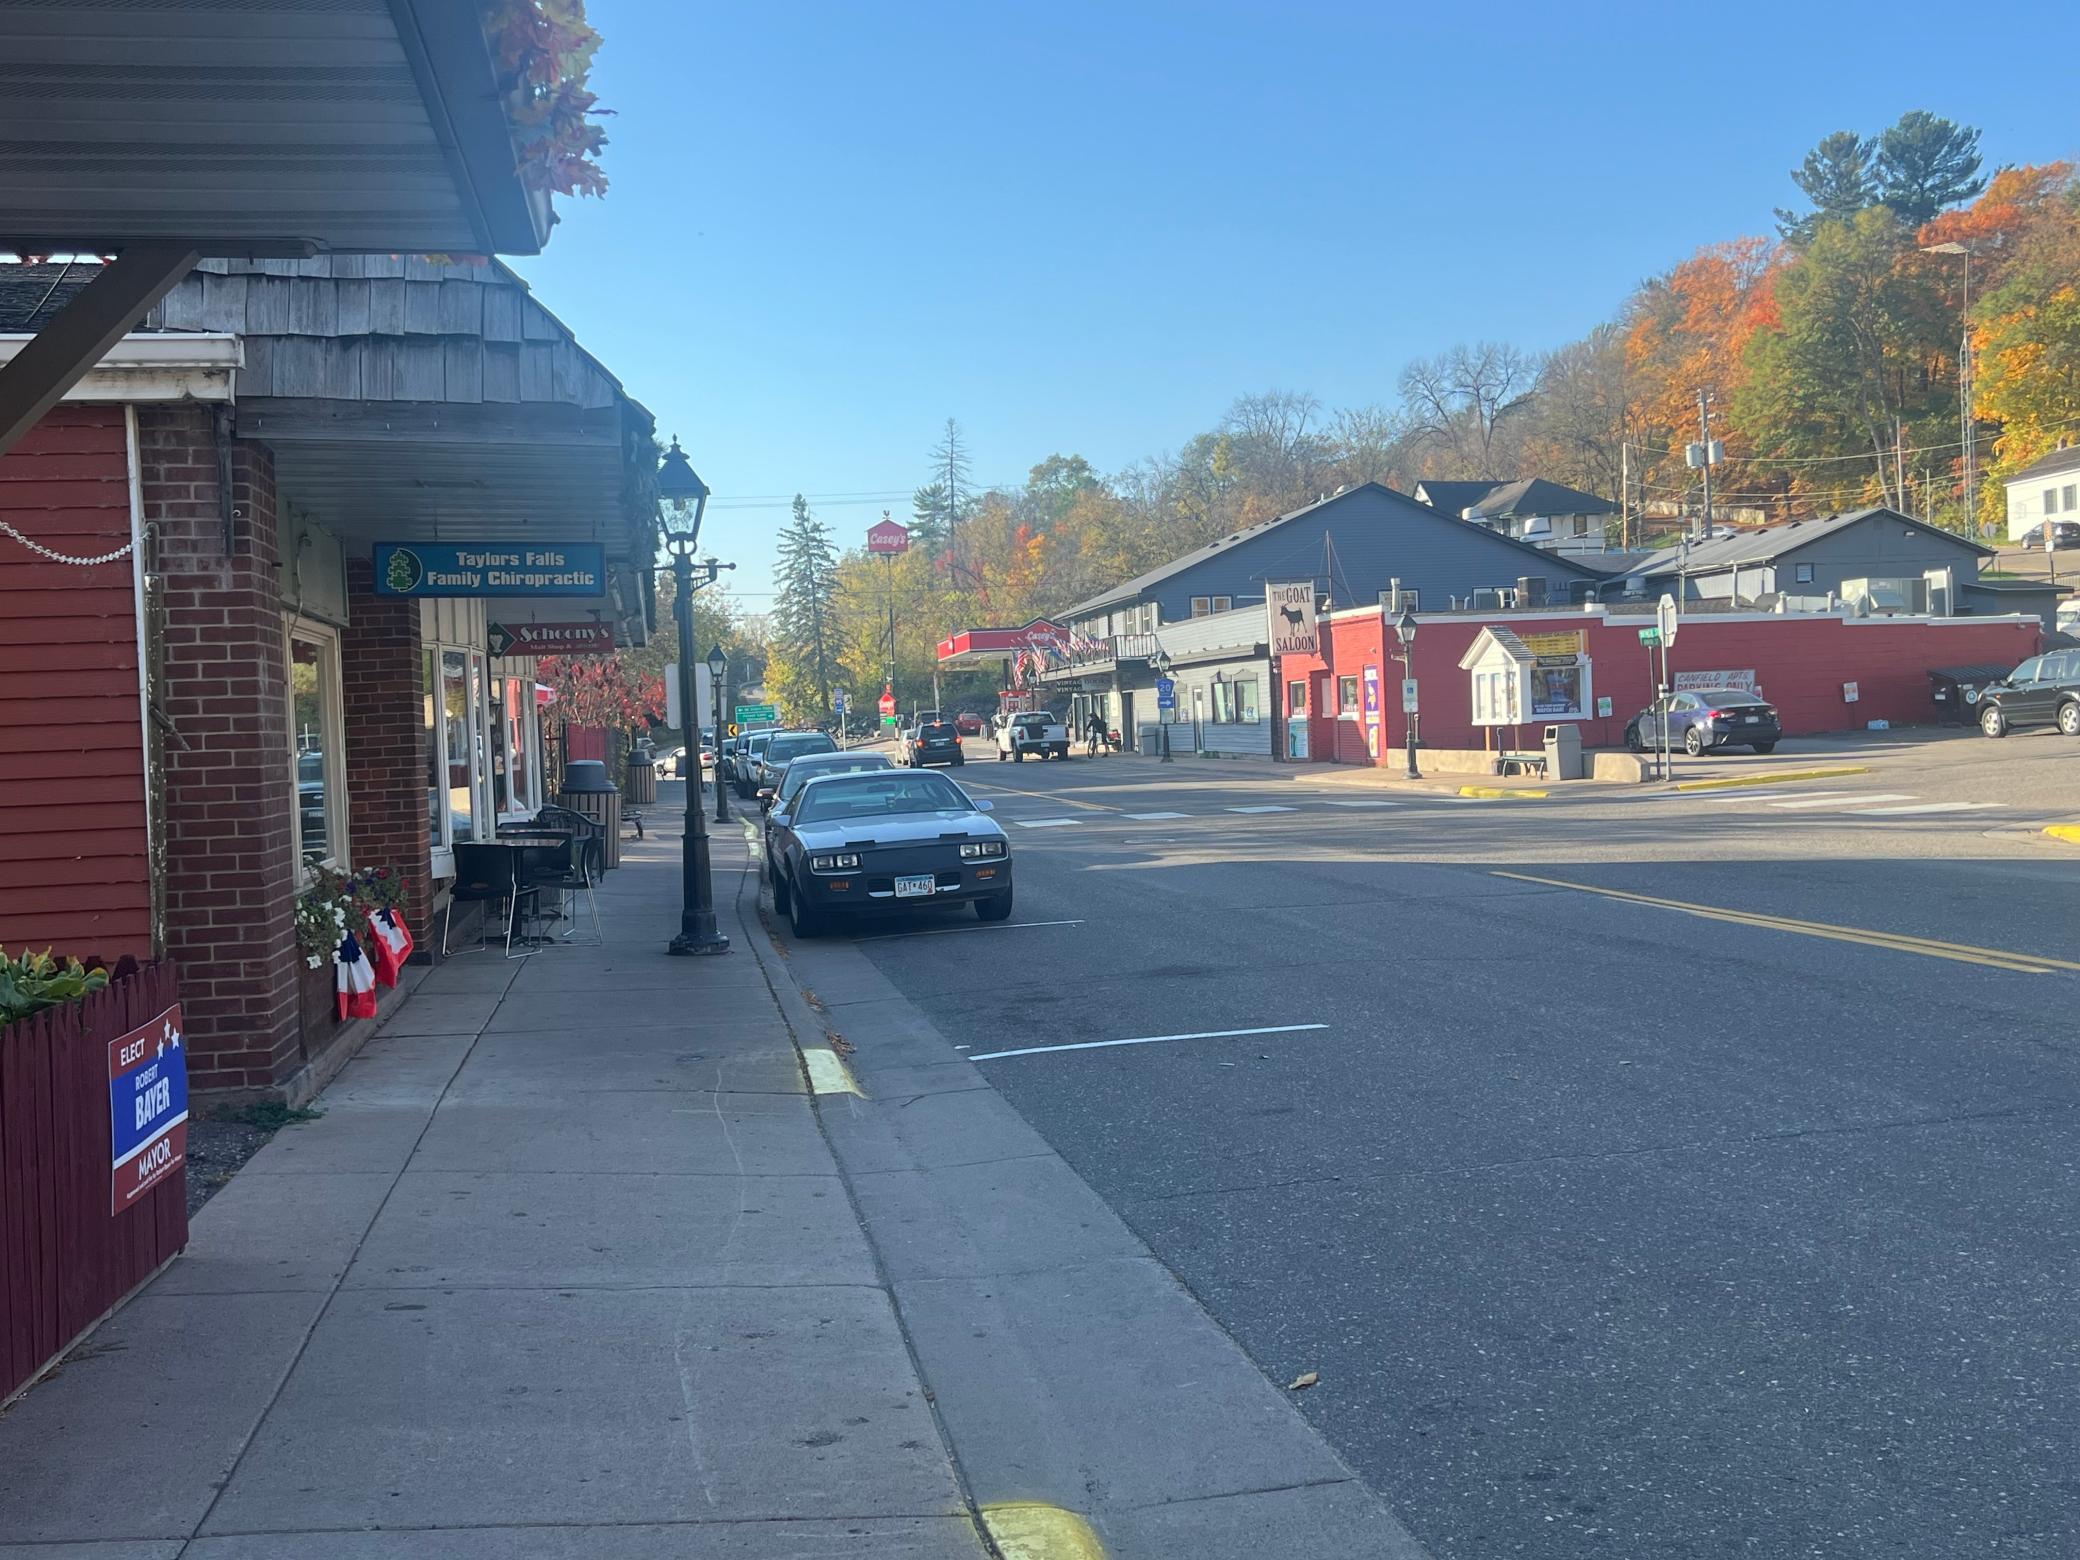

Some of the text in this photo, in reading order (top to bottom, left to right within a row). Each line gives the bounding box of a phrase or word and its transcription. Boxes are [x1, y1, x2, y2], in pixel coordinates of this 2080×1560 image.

[870, 533, 906, 547] Casey's
[456, 551, 565, 568] Taylors Falls
[427, 571, 595, 588] Family Chiropractic
[1273, 586, 1311, 603] THE GOAT
[519, 626, 609, 643] Schoony's
[1276, 636, 1315, 652] SALOON
[1678, 672, 1721, 682] CANFIELD
[1160, 684, 1171, 692] 20
[120, 1038, 145, 1067] ELECT
[135, 1063, 158, 1092] ROBERT
[135, 1076, 170, 1131] BAYER
[138, 1137, 171, 1181] MAYOR
